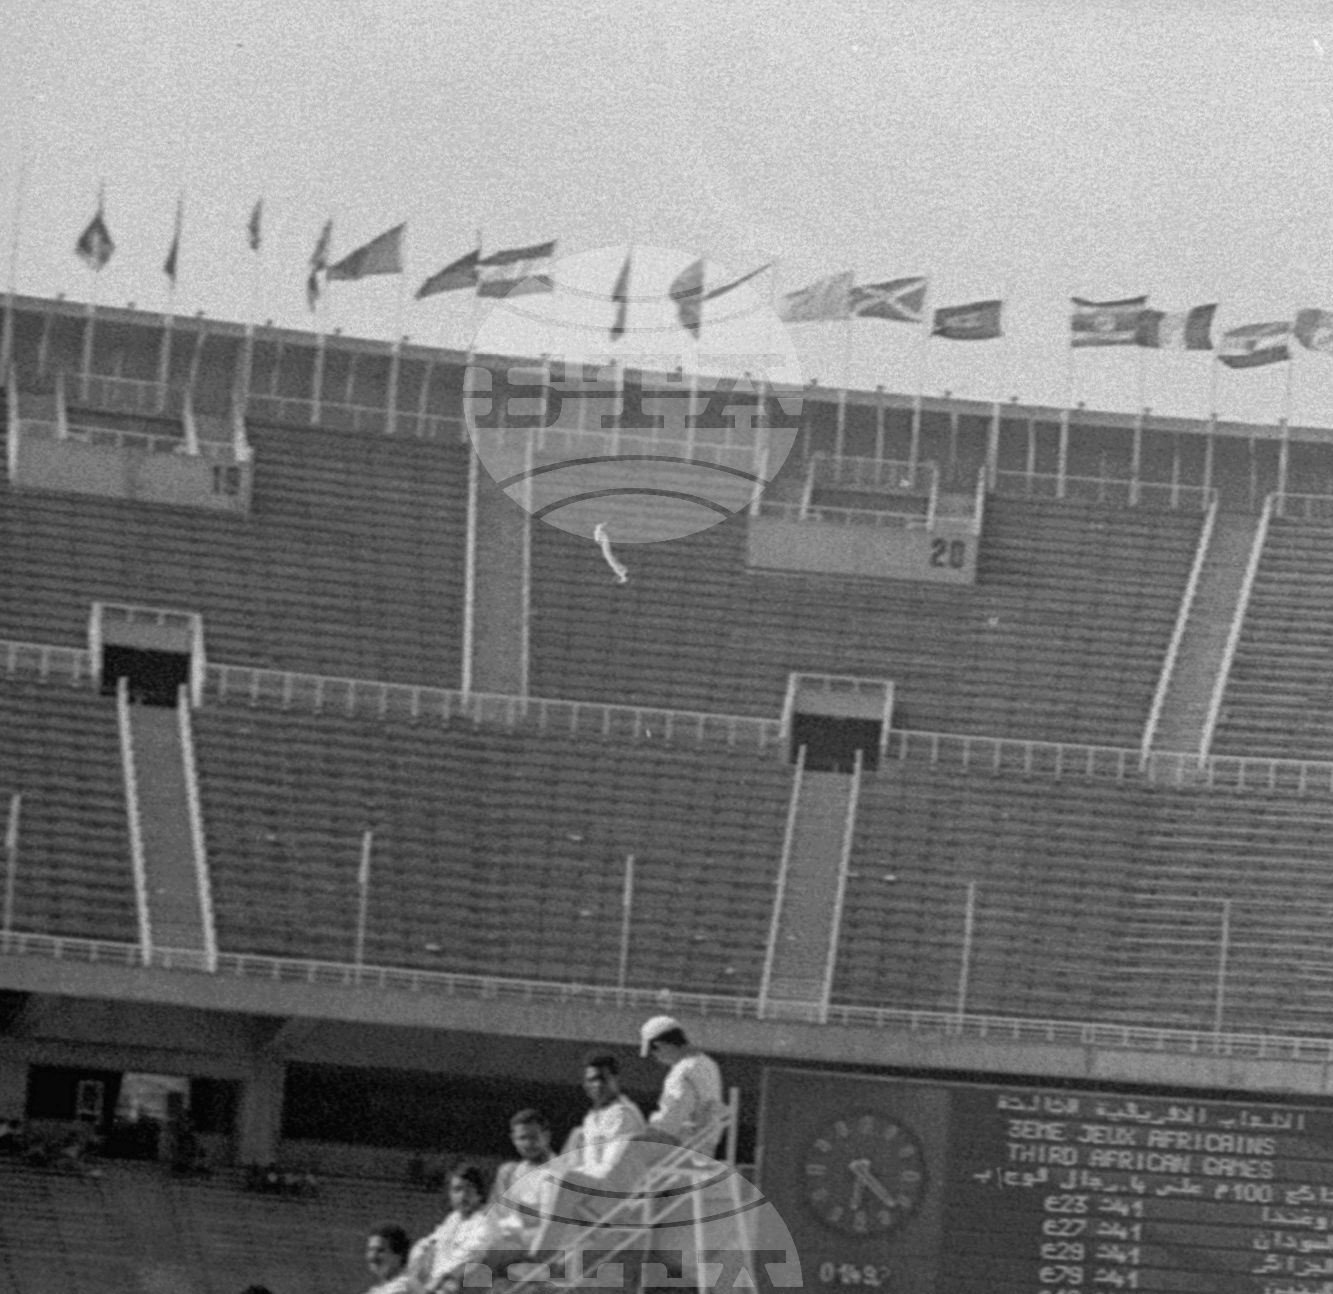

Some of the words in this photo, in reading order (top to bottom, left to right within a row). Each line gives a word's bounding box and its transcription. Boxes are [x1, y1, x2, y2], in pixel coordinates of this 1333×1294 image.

[929, 538, 966, 570] 20
[1077, 1124, 1141, 1146] JEUX
[1148, 1129, 1276, 1155] AFRICAINS
[1006, 1142, 1079, 1166] THIRD
[1088, 1149, 1192, 1174] AFRICAN
[1202, 1156, 1275, 1179] GAMES
